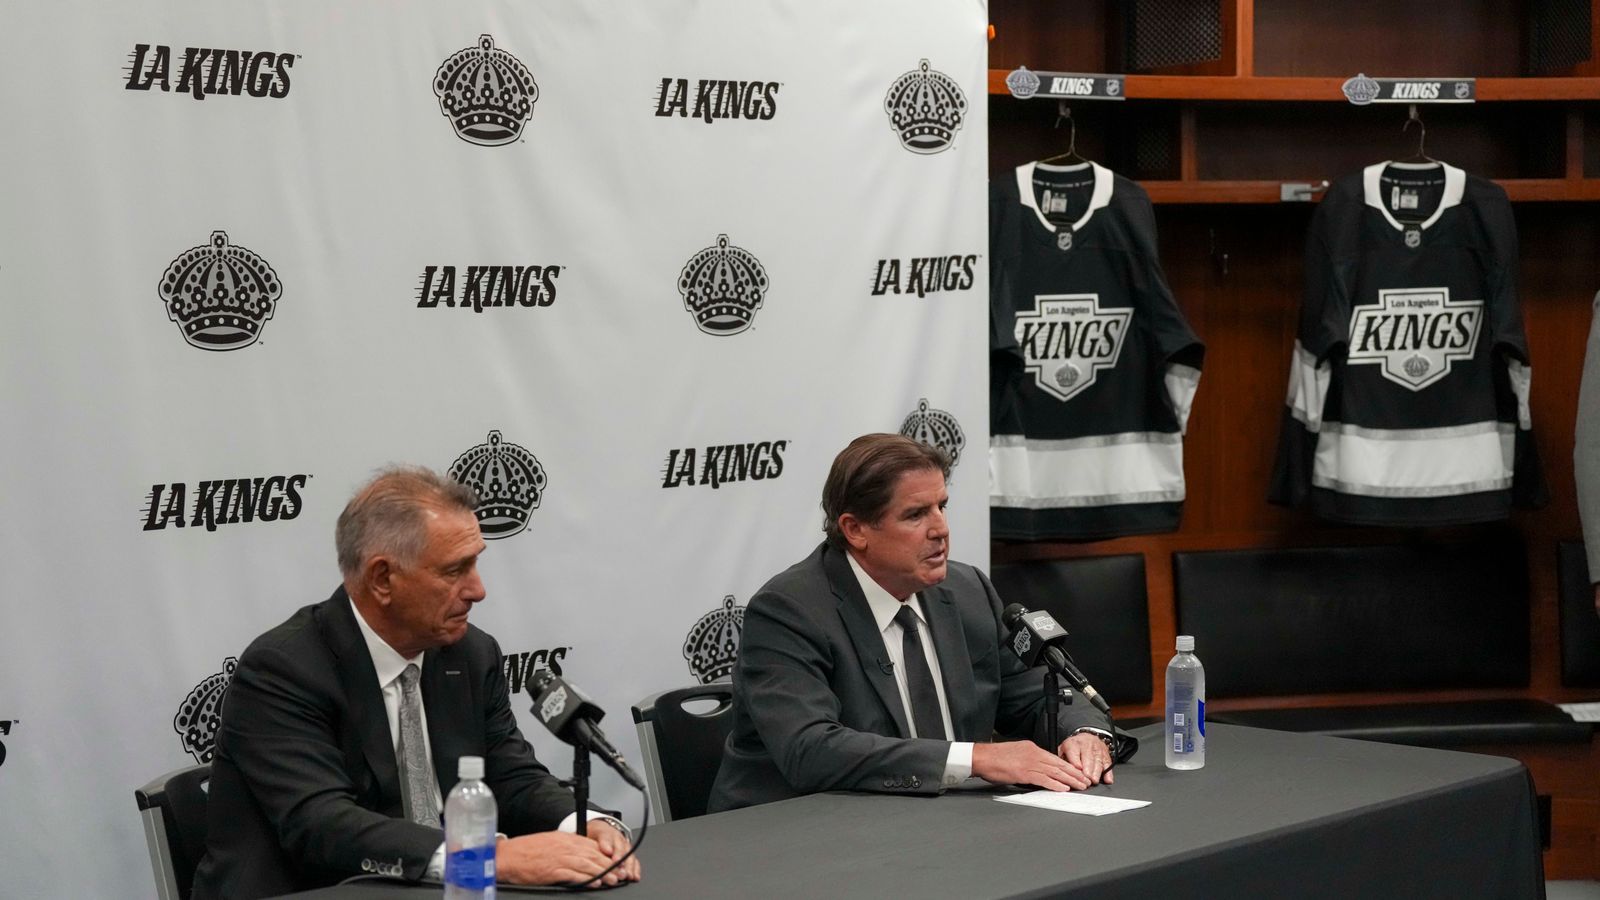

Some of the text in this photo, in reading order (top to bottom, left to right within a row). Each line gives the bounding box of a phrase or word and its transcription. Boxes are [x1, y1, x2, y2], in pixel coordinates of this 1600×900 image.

[123, 44, 295, 101] LA KINGS
[1049, 76, 1094, 95] KINGS
[1391, 82, 1441, 99] KINGS
[654, 77, 780, 124] LA KINGS
[416, 265, 561, 313] LA KINGS
[870, 254, 977, 299] LA KINGS
[1046, 306, 1090, 316] Los Angeles
[1390, 298, 1440, 309] Los Angeles
[1021, 319, 1121, 360] KINGS
[1356, 311, 1475, 352] KINGS
[662, 440, 787, 489] LA KINGS
[142, 474, 307, 532] LA KINGS
[503, 647, 567, 694] NGS
